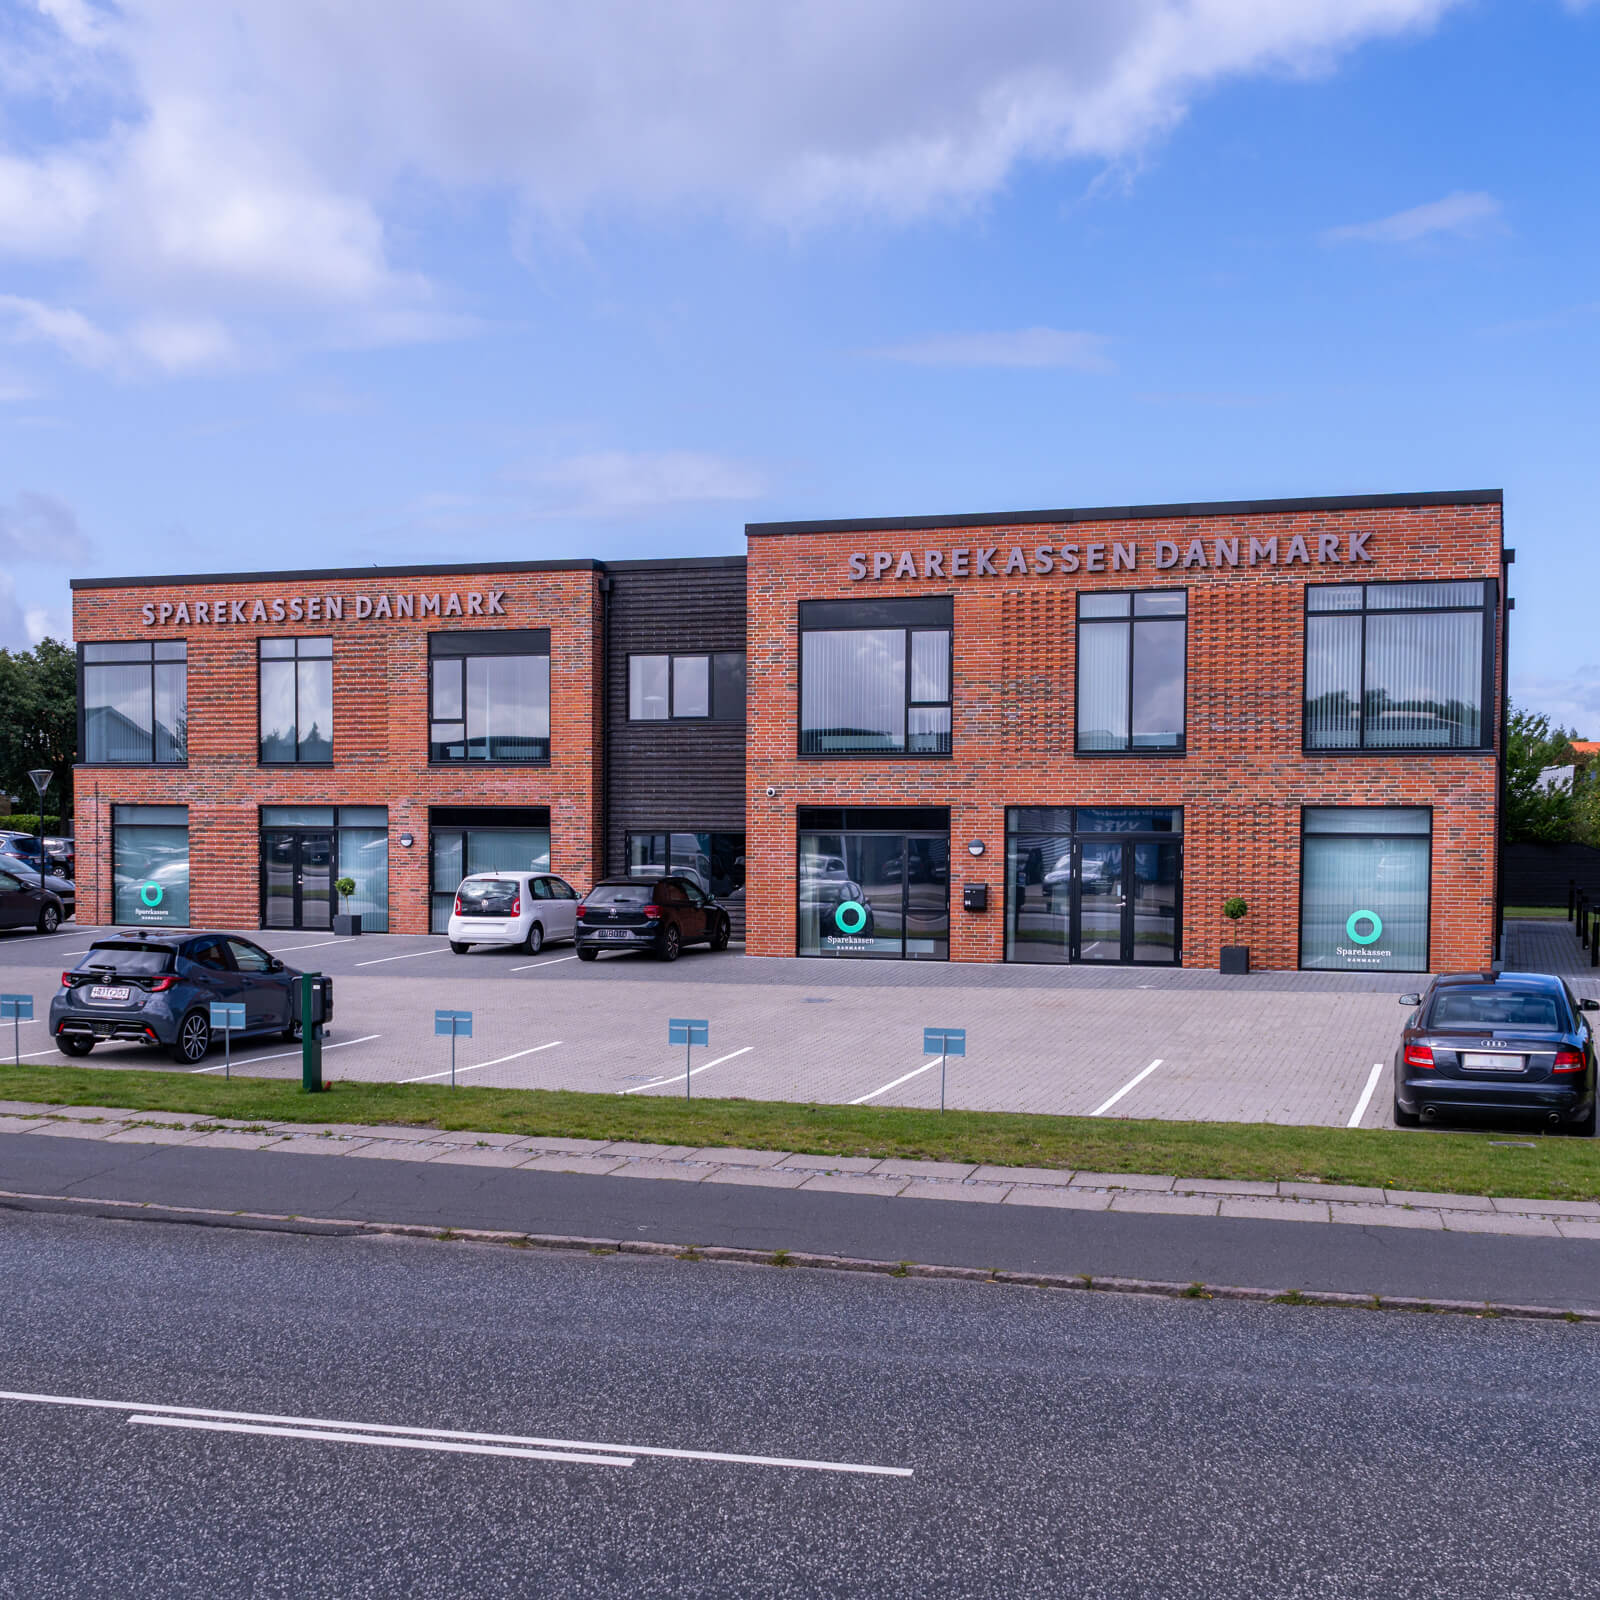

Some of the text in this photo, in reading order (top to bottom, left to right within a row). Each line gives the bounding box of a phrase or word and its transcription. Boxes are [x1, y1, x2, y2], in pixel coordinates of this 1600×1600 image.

[848, 532, 1373, 581] SPAREKASSEN DANMARK
[142, 591, 506, 625] SPAREKASSEN DANMARK
[827, 935, 875, 945] Sparekassen
[1336, 946, 1392, 957] Sparekassen
